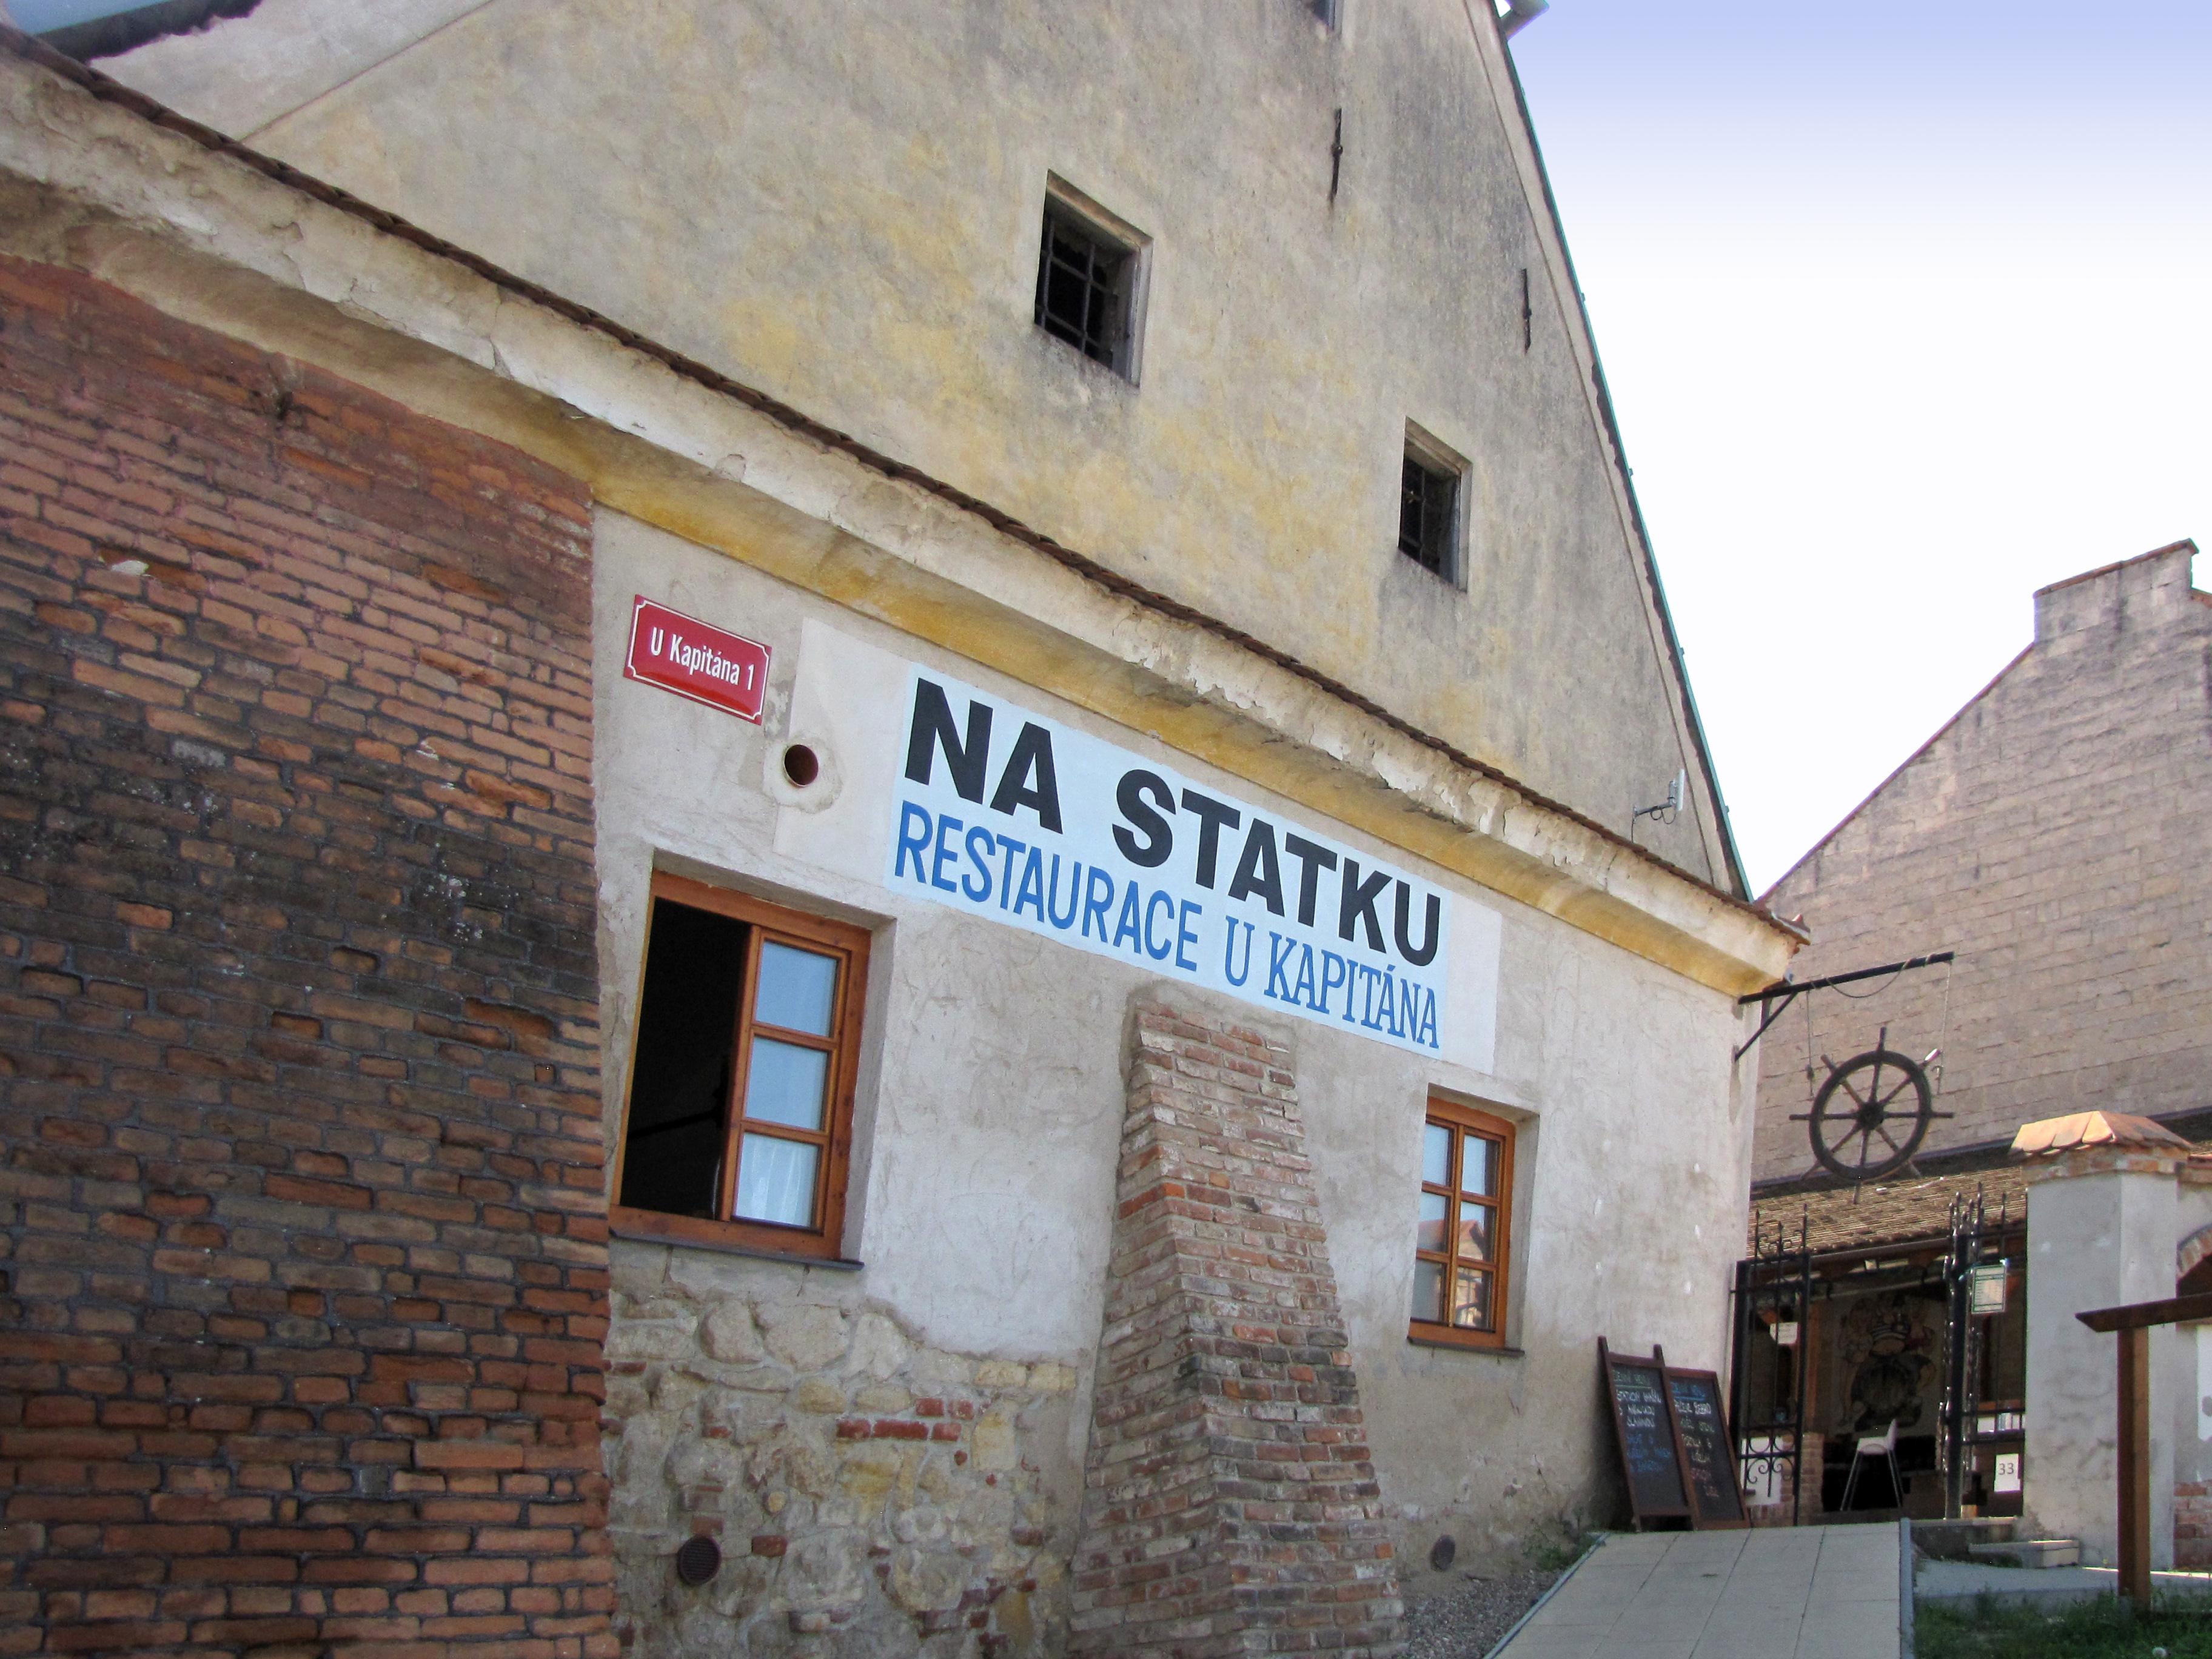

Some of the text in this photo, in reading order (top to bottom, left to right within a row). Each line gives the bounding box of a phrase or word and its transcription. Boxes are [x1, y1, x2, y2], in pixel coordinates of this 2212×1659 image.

[650, 626, 754, 690] U Kapitána 1
[905, 677, 1441, 967] NA STATKU
[894, 800, 1439, 1048] RESTAURACE U KAPITÁNA
[1998, 1463, 2014, 1475] 33
